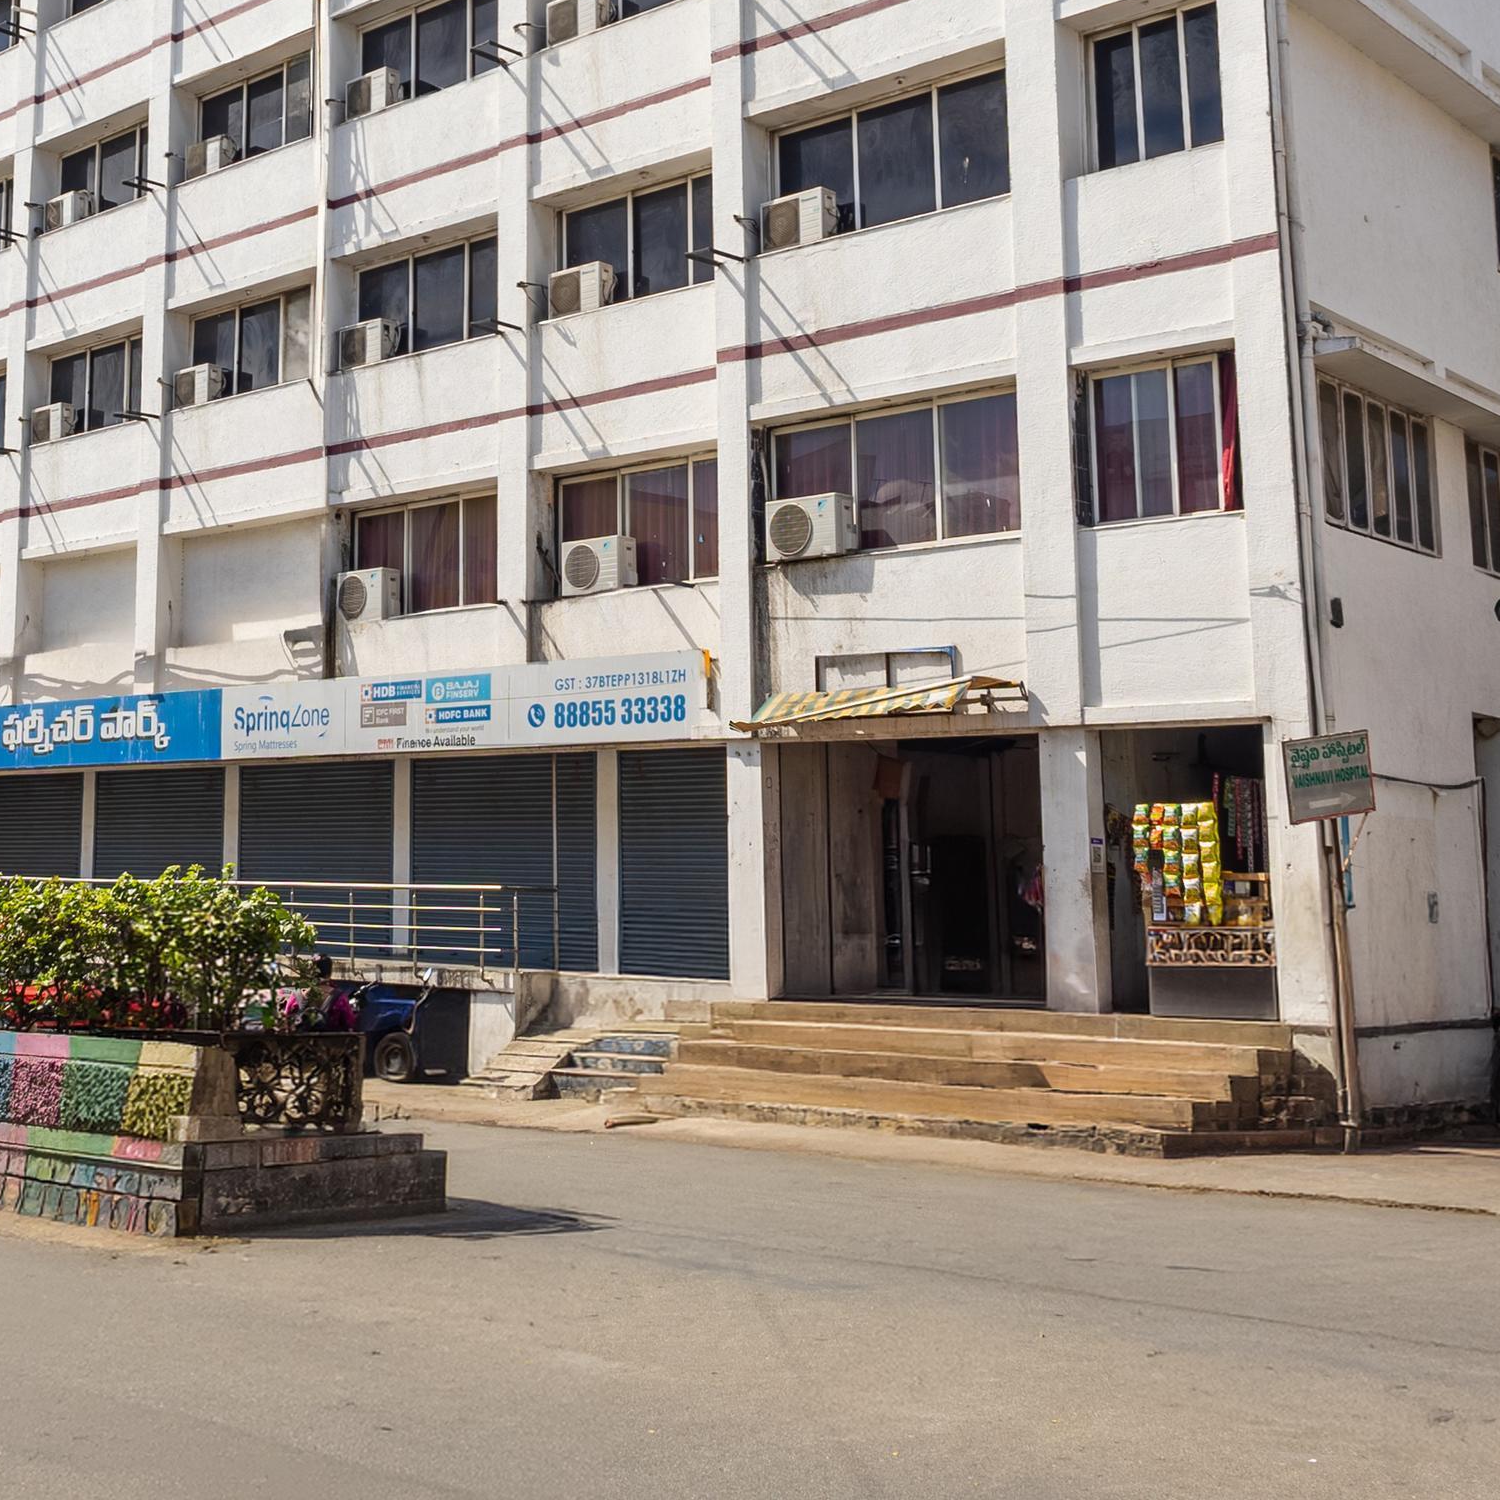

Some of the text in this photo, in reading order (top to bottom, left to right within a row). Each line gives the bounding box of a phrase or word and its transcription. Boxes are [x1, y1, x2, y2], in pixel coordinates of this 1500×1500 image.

[446, 680, 480, 690] BAJAJ
[554, 677, 576, 691] GST
[585, 668, 687, 689] 37BTEPP1318L1ZH
[373, 686, 396, 698] HDB
[446, 689, 479, 699] FINSERV
[438, 708, 488, 720] HDFC BANK
[554, 694, 687, 729] 88855 33338
[234, 740, 297, 753] Spring Mattresses
[433, 734, 476, 747] Available
[1292, 764, 1369, 789] VAISHNAVI HOSPITAL
